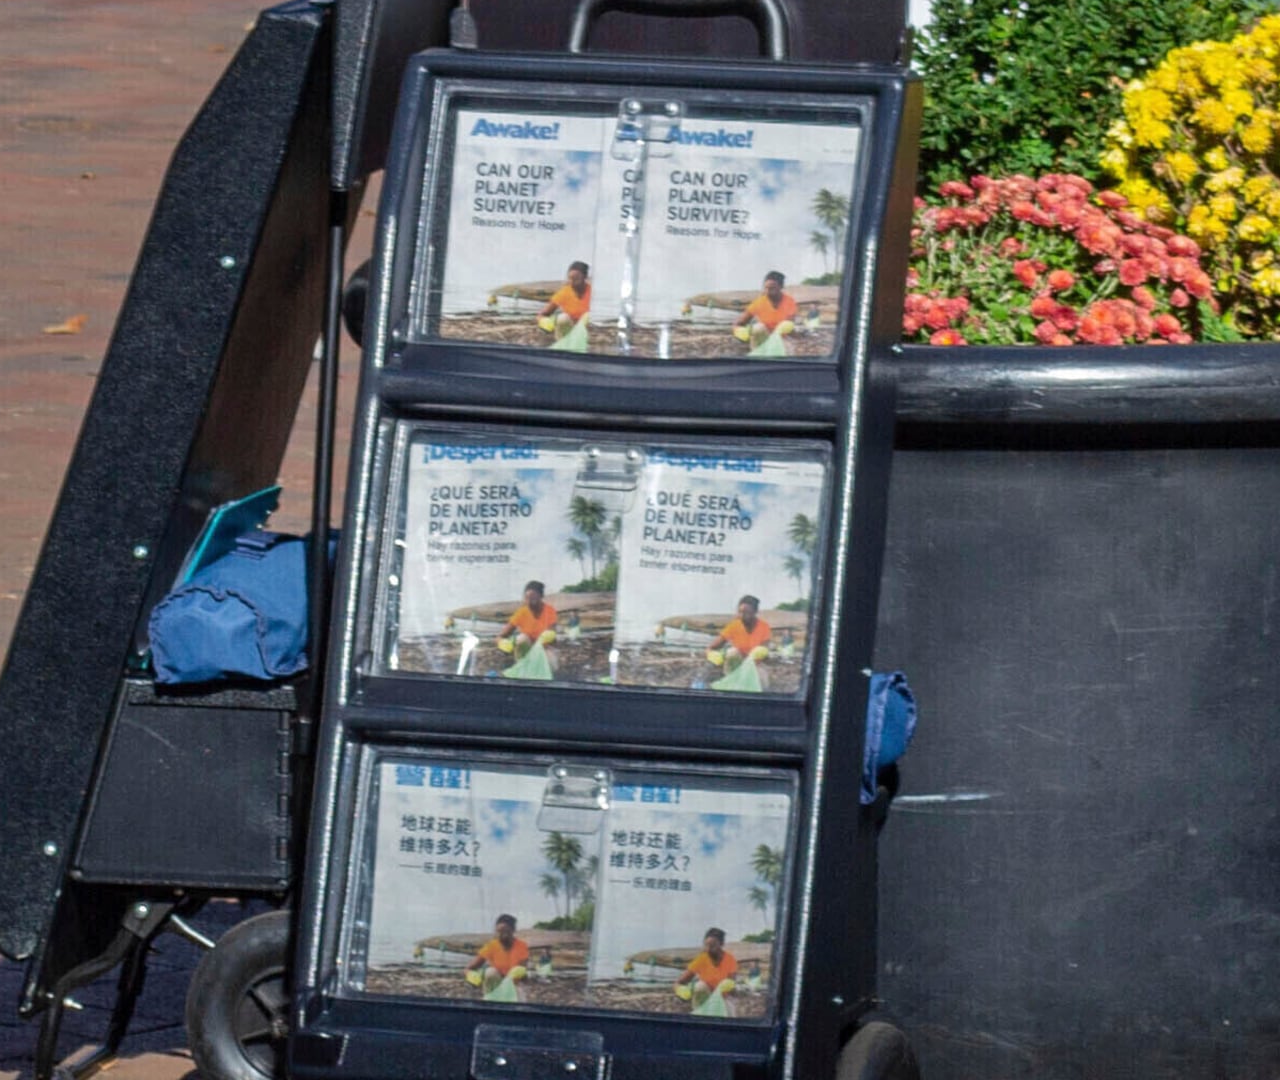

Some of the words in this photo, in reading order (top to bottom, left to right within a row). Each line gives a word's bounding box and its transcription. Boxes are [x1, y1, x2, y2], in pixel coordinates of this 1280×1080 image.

[471, 118, 560, 140] Awake!
[668, 125, 754, 149] Awake!
[476, 162, 511, 177] CAN
[518, 164, 554, 180] OUR
[670, 170, 705, 185] CAN
[712, 173, 748, 188] OUR
[475, 180, 539, 197] PLANET
[669, 188, 734, 205] PLANET
[474, 198, 555, 216] SURVIVE?
[668, 206, 750, 224] SURVIVE?
[472, 217, 517, 228] Reasons
[520, 219, 536, 229] for
[539, 221, 566, 232] Hope
[666, 225, 710, 237] Reasons
[714, 227, 729, 237] for
[732, 229, 761, 240] Hope
[430, 482, 473, 501] ¿QUÉ
[479, 482, 520, 500] SERÁ
[430, 503, 451, 518] DE
[457, 503, 532, 518] NUESTRO
[698, 493, 741, 511] SERÁ
[429, 521, 508, 536] PLANETA?
[645, 508, 667, 524] DE
[673, 511, 752, 531] NUESTRO
[643, 526, 726, 547] PLANETA?
[427, 542, 447, 553] Hay
[450, 542, 491, 551] razones
[493, 542, 517, 552] para
[640, 547, 660, 558] Hay
[664, 549, 706, 561] razones
[709, 552, 733, 564] para
[426, 554, 455, 562] tener
[458, 554, 510, 565] esperanza
[639, 560, 668, 570] tener
[670, 563, 726, 576] esperanza
[401, 814, 472, 836] 地球还能
[400, 836, 481, 858] 维持多久?
[612, 829, 682, 850] 地球还能
[610, 851, 691, 872] 维持多久?
